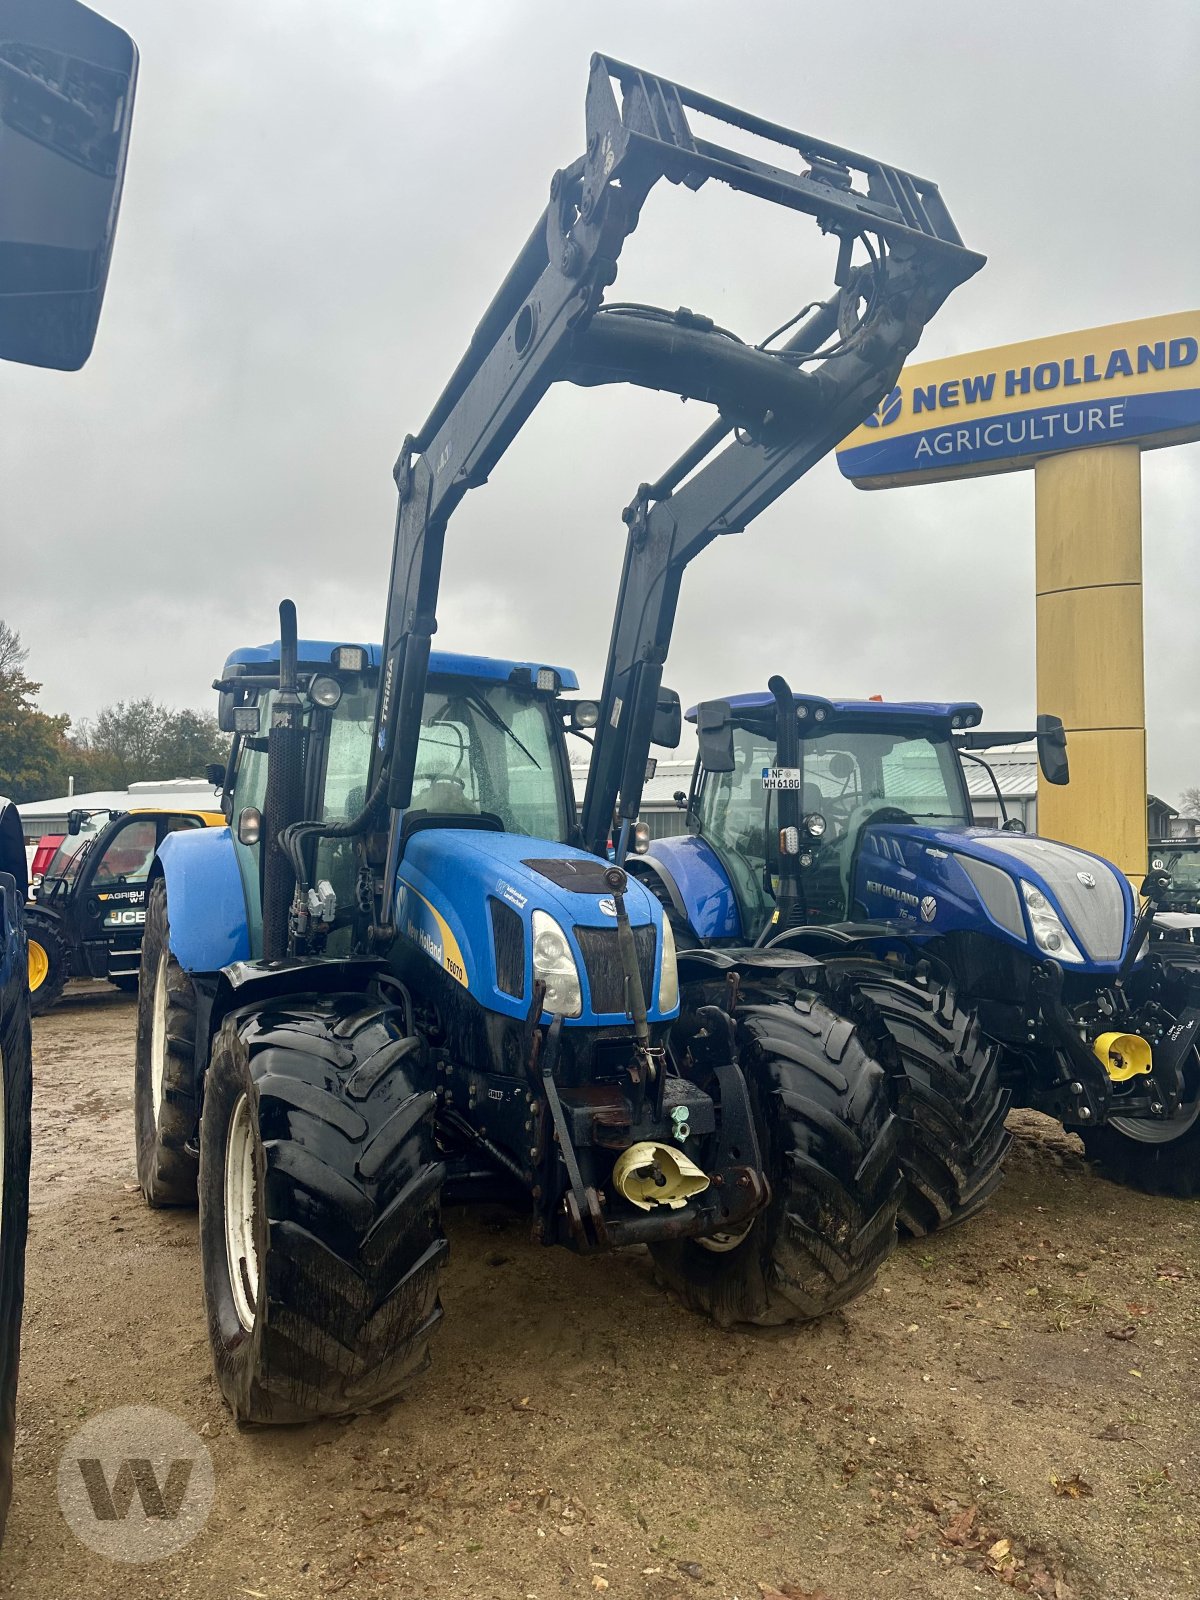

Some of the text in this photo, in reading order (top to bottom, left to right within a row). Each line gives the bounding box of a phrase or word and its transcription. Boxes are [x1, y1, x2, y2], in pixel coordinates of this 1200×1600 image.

[912, 336, 1199, 415] NEW HOLLAND
[914, 403, 1125, 459] AGRICULTURE
[381, 658, 394, 723] TRIMA
[763, 779, 776, 789] WH
[771, 769, 784, 779] NF
[1154, 860, 1162, 869] 40
[866, 880, 919, 908] NEW HOLLAND
[407, 918, 442, 962] New Holland
[446, 957, 463, 981] T6070
